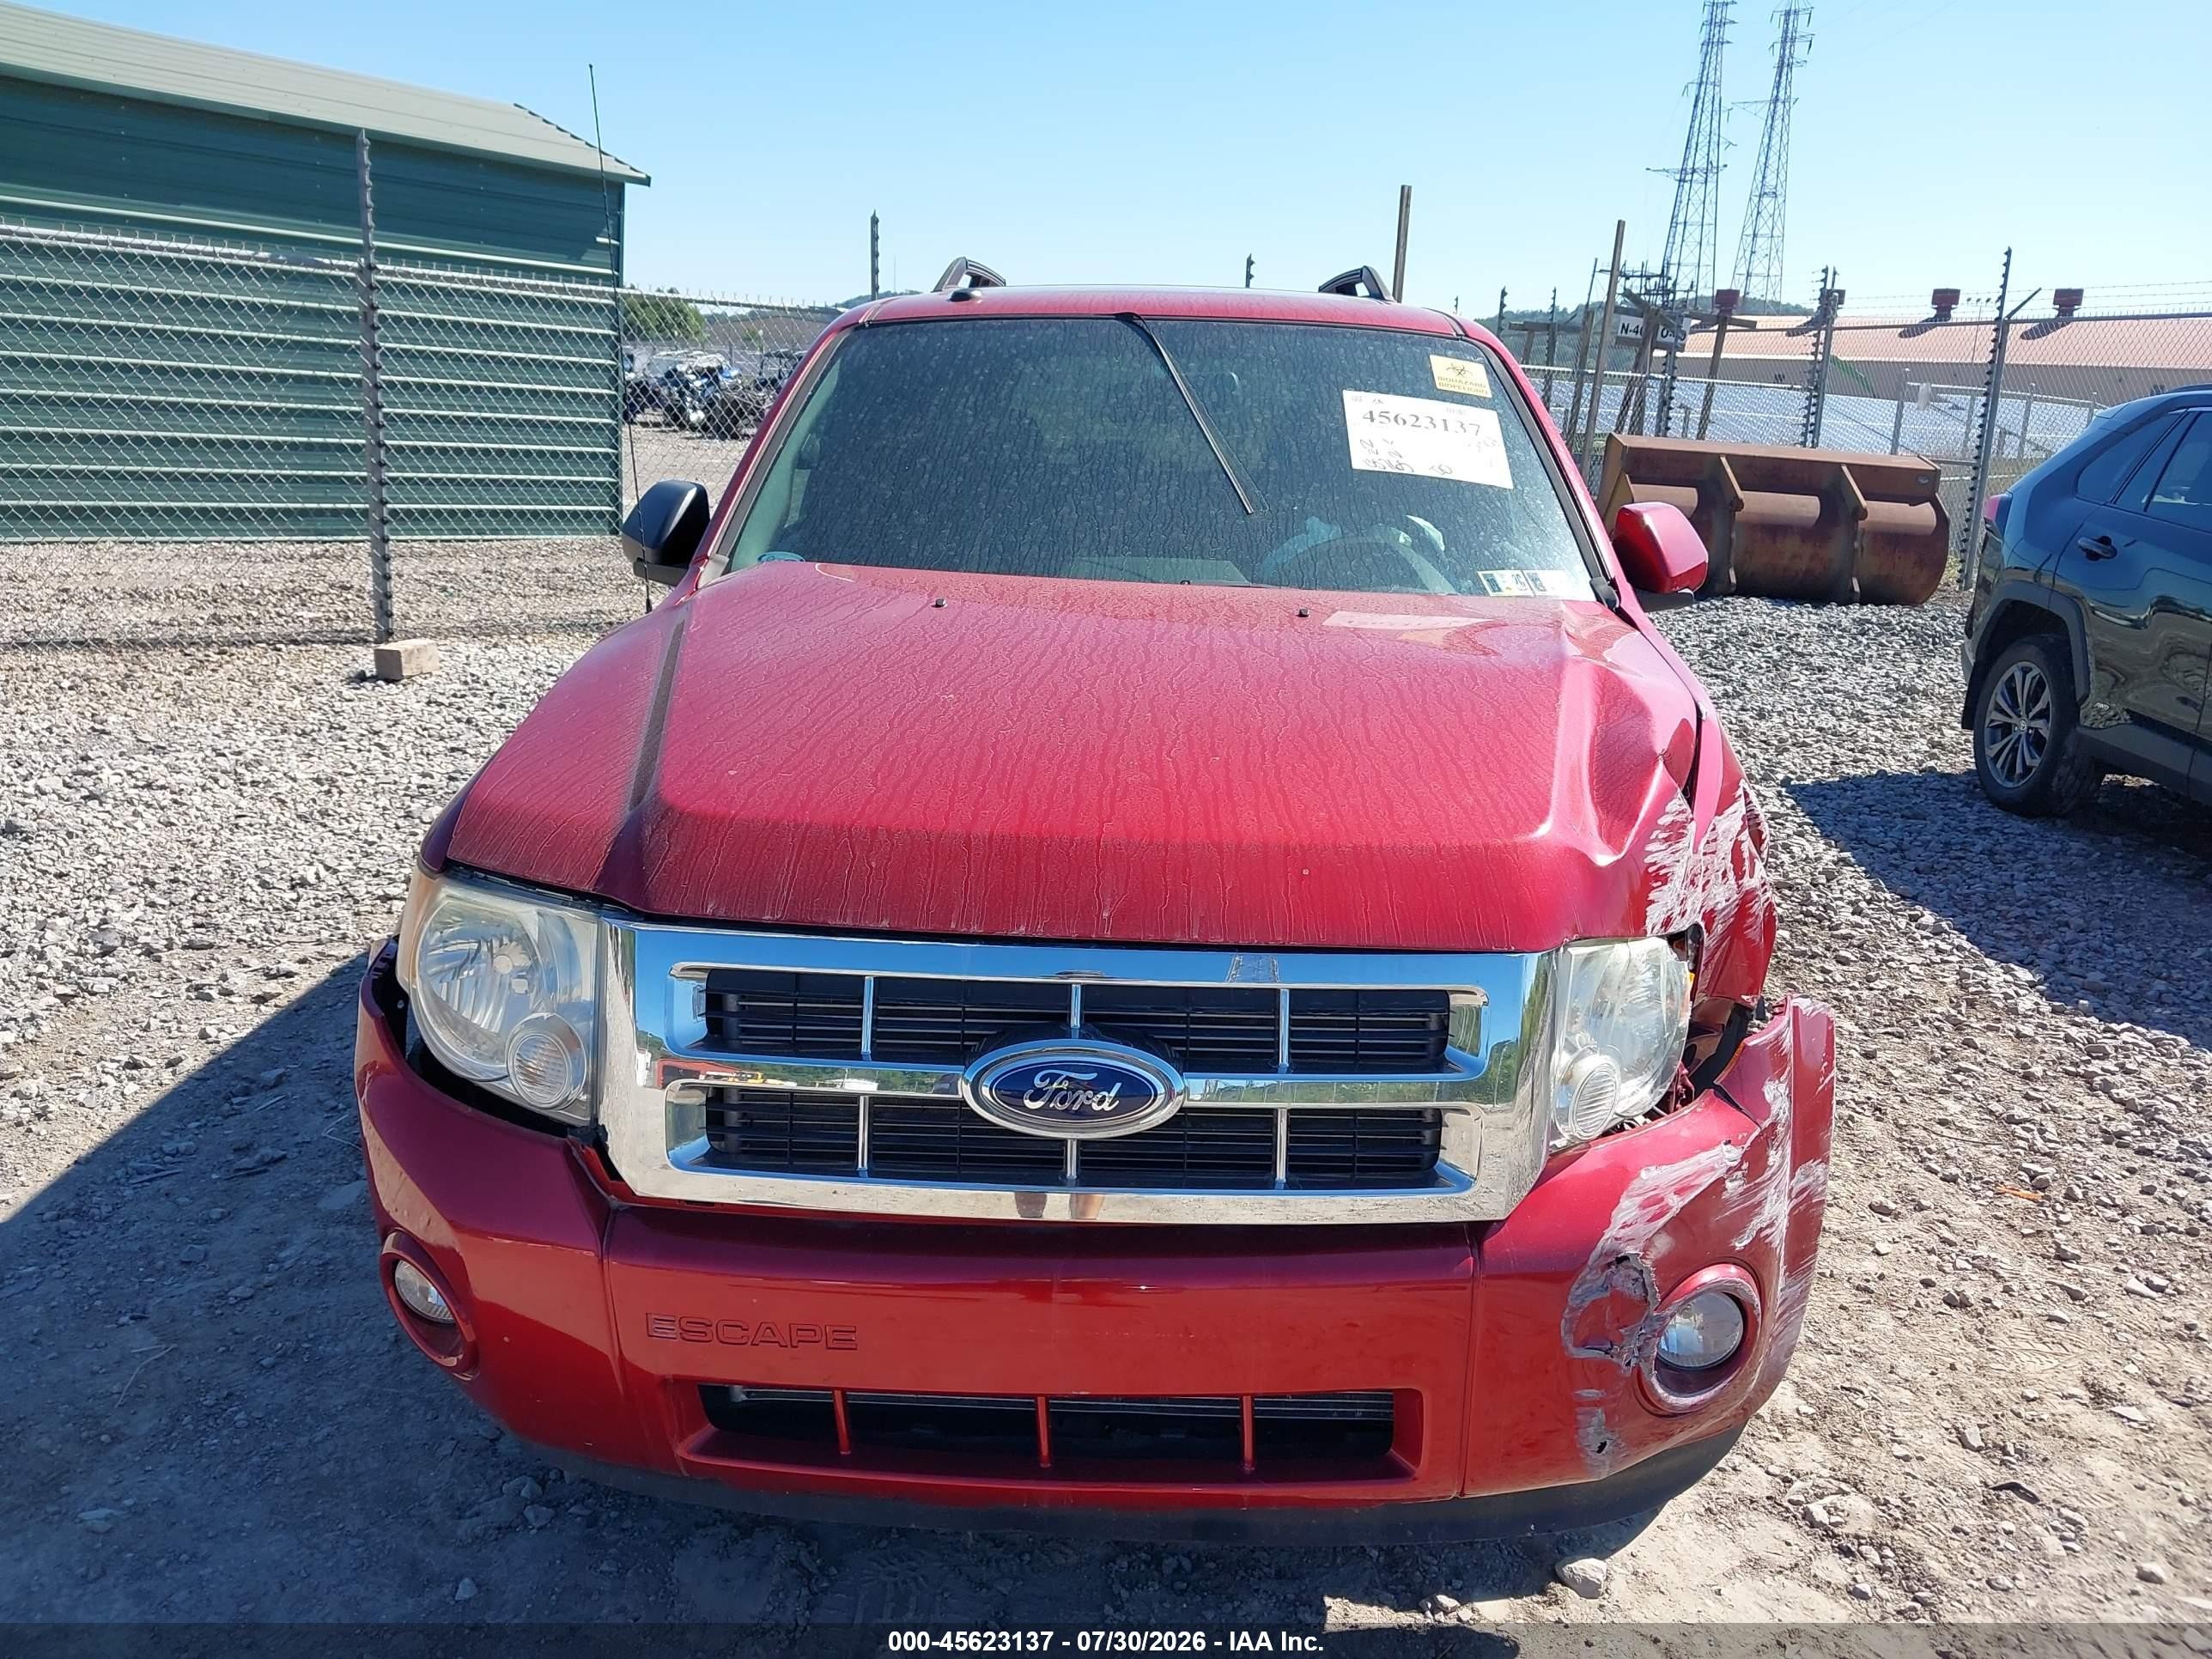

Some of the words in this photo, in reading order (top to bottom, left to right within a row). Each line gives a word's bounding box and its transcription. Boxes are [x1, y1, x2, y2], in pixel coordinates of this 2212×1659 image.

[1362, 410, 1480, 436] 45623137
[1024, 1069, 1121, 1111] Ford
[646, 1312, 858, 1351] ESCAPE
